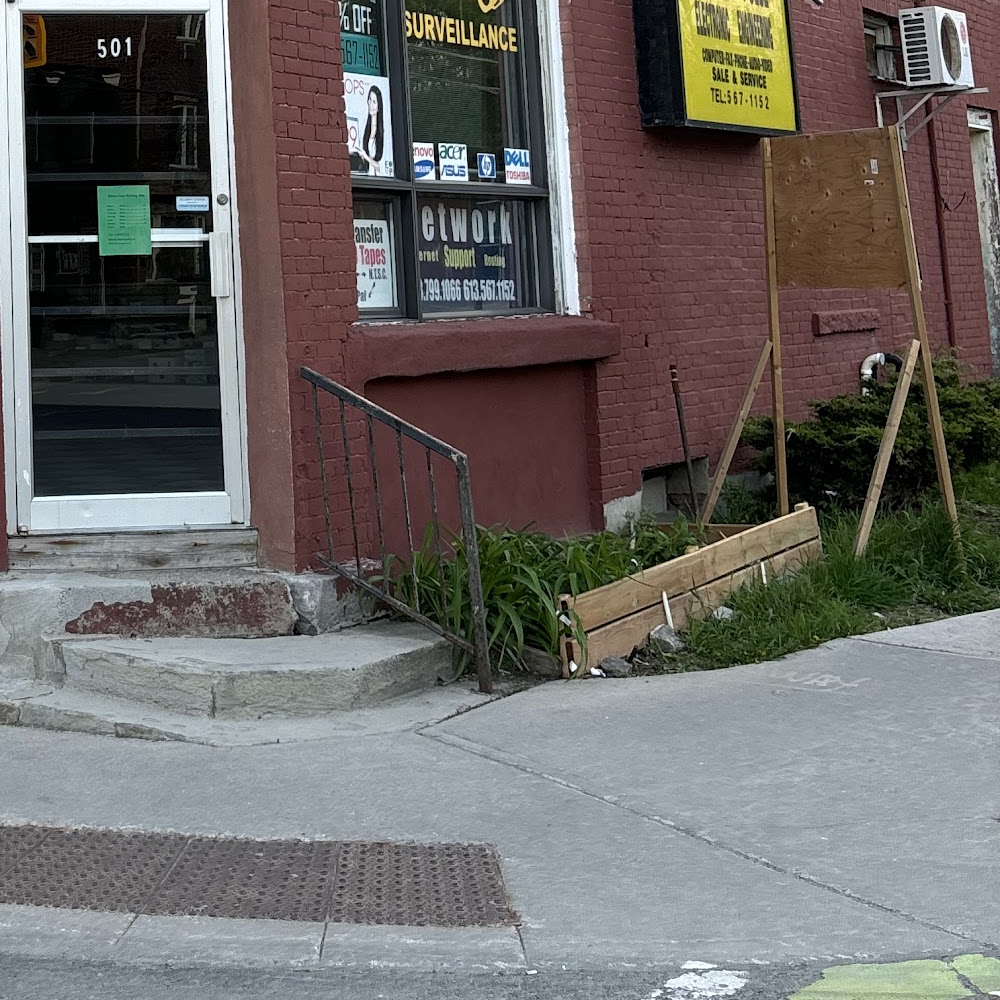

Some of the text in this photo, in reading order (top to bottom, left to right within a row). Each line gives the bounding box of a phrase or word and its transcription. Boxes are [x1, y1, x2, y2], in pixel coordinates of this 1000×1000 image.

[352, 4, 372, 35] OFF
[404, 10, 518, 53] SURVEILLANCE
[97, 37, 132, 58] 501
[712, 66, 767, 89] SALE & SERVICE
[440, 145, 465, 160] acer
[504, 150, 529, 167] DELL
[441, 165, 466, 177] ASUS
[506, 170, 530, 181] TOSHIBA
[421, 201, 512, 244] etwork
[355, 224, 383, 244] ansfer
[359, 245, 386, 267] Tapes
[418, 250, 439, 262] ernet
[443, 244, 476, 270] Support
[463, 279, 516, 301] 613.567.1152
